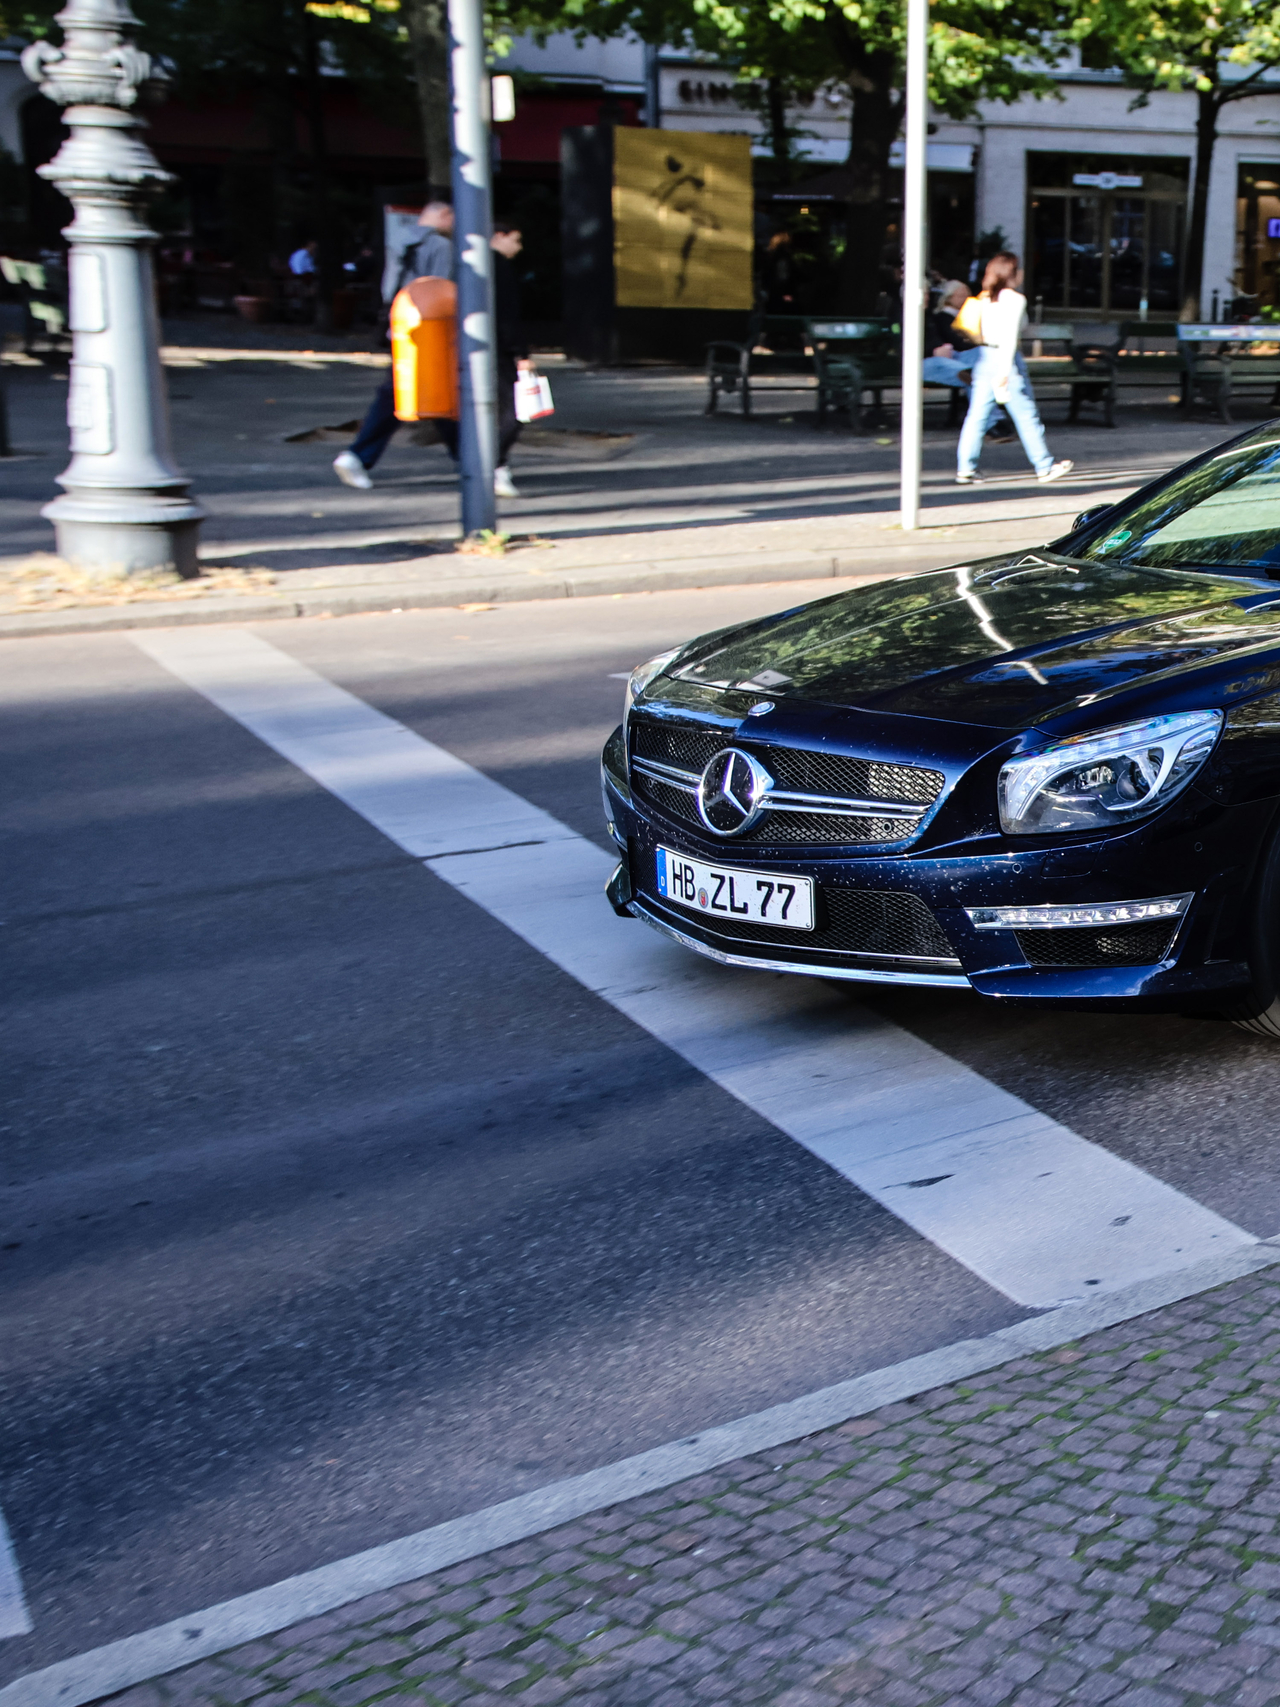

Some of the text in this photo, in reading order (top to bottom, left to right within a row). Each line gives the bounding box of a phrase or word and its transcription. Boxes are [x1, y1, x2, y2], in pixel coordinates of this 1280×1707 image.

[672, 859, 796, 920] HB ZL 77
